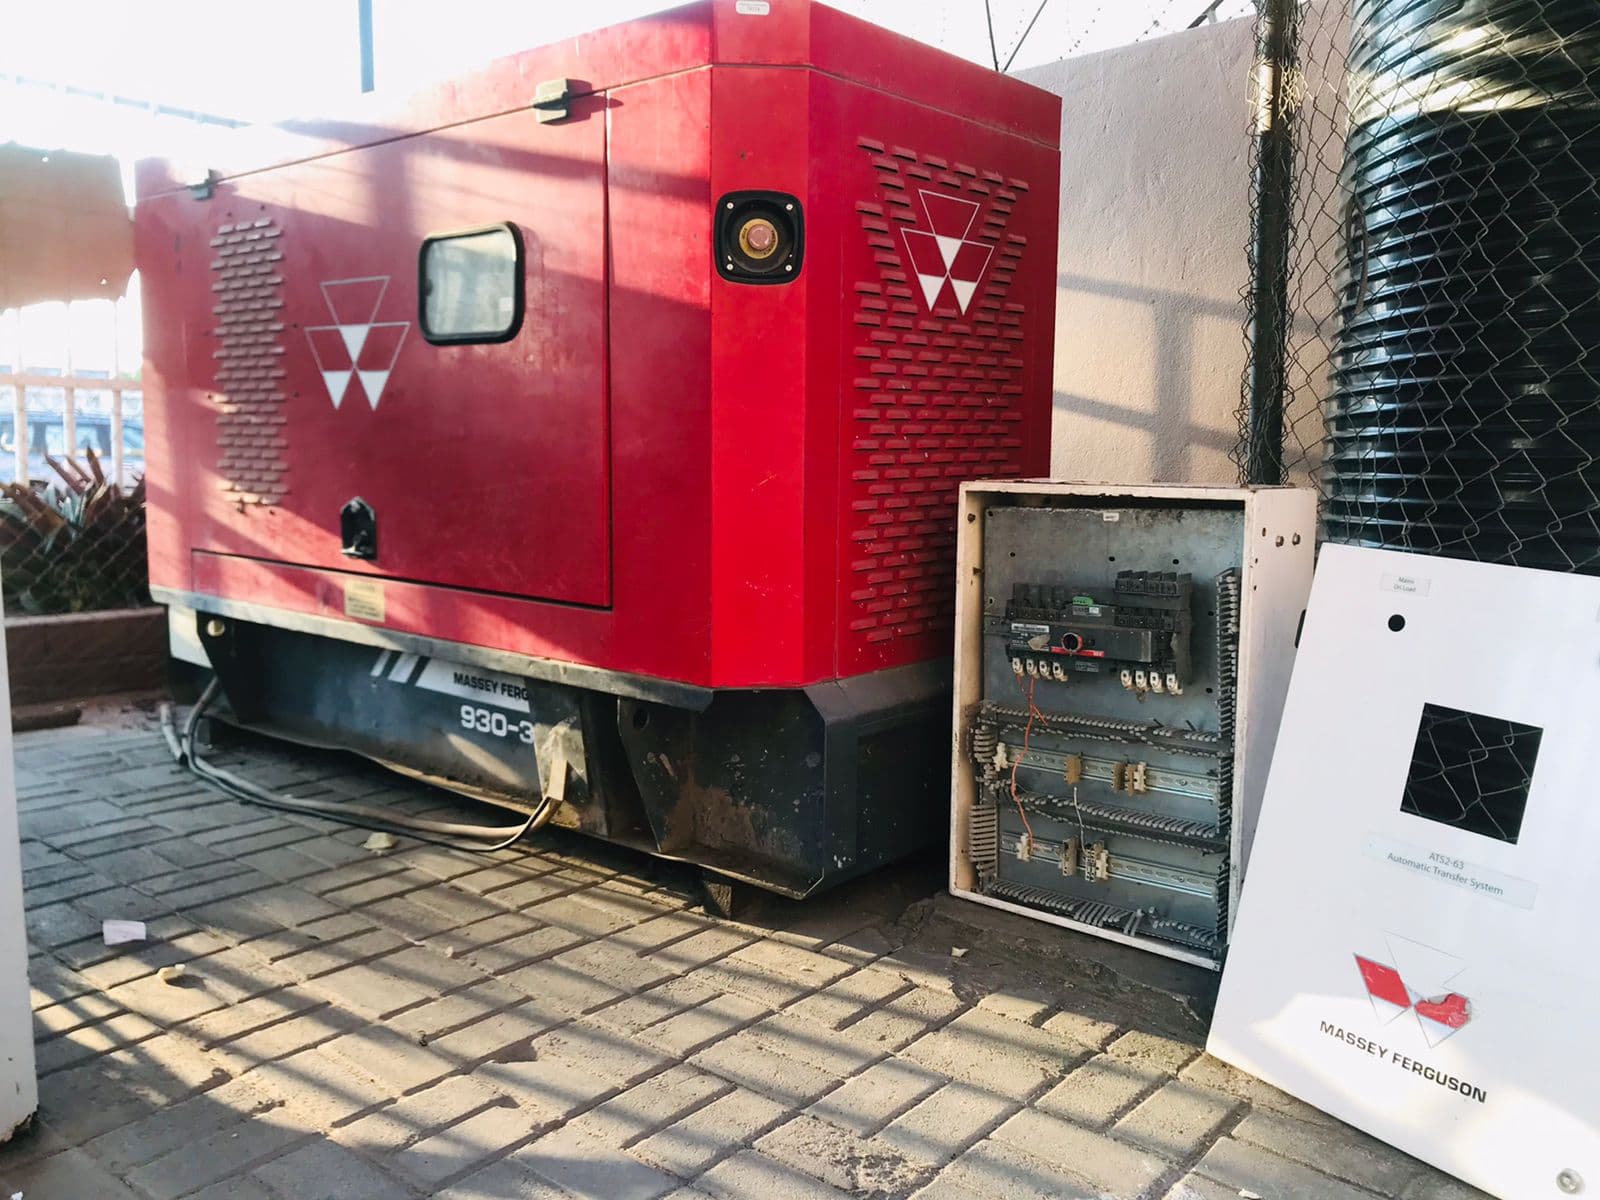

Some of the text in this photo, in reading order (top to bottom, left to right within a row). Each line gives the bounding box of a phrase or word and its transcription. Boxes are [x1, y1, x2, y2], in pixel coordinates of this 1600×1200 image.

[453, 672, 499, 693] MASSEY
[1387, 852, 1504, 896] Automatic Transfer System
[1428, 852, 1465, 870] ATS2-63
[1319, 1020, 1488, 1104] MASSEY FERGUSON
